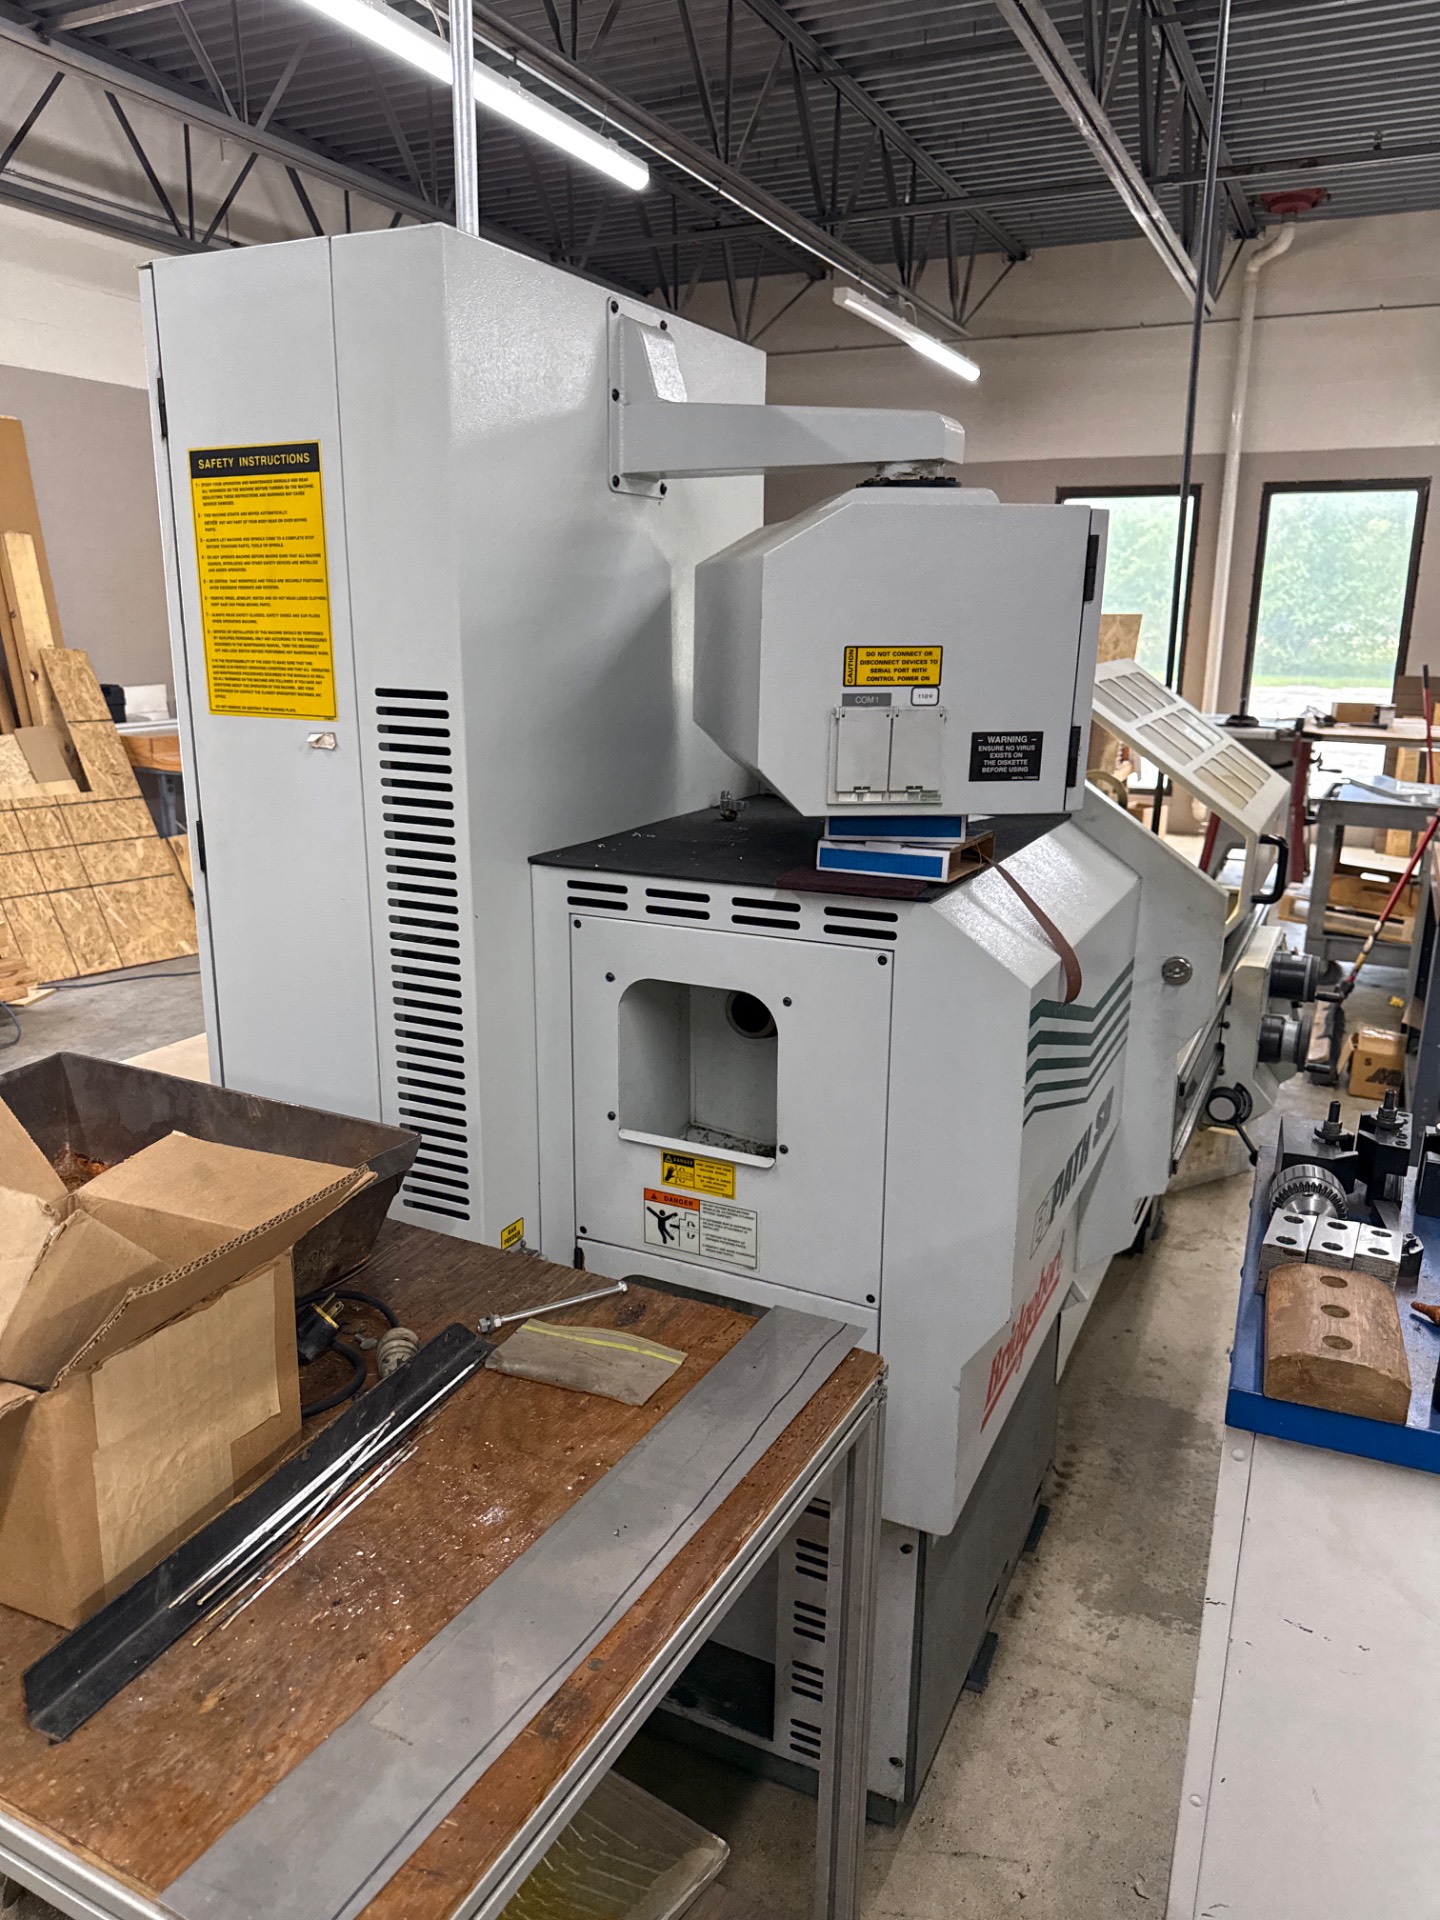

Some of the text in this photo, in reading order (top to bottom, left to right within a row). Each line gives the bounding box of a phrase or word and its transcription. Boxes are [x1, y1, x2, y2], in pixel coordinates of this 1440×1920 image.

[198, 453, 310, 469] SAFETY INSTRUCTIONS
[1050, 1121, 1092, 1224] PATH
[664, 1195, 693, 1207] DANGER
